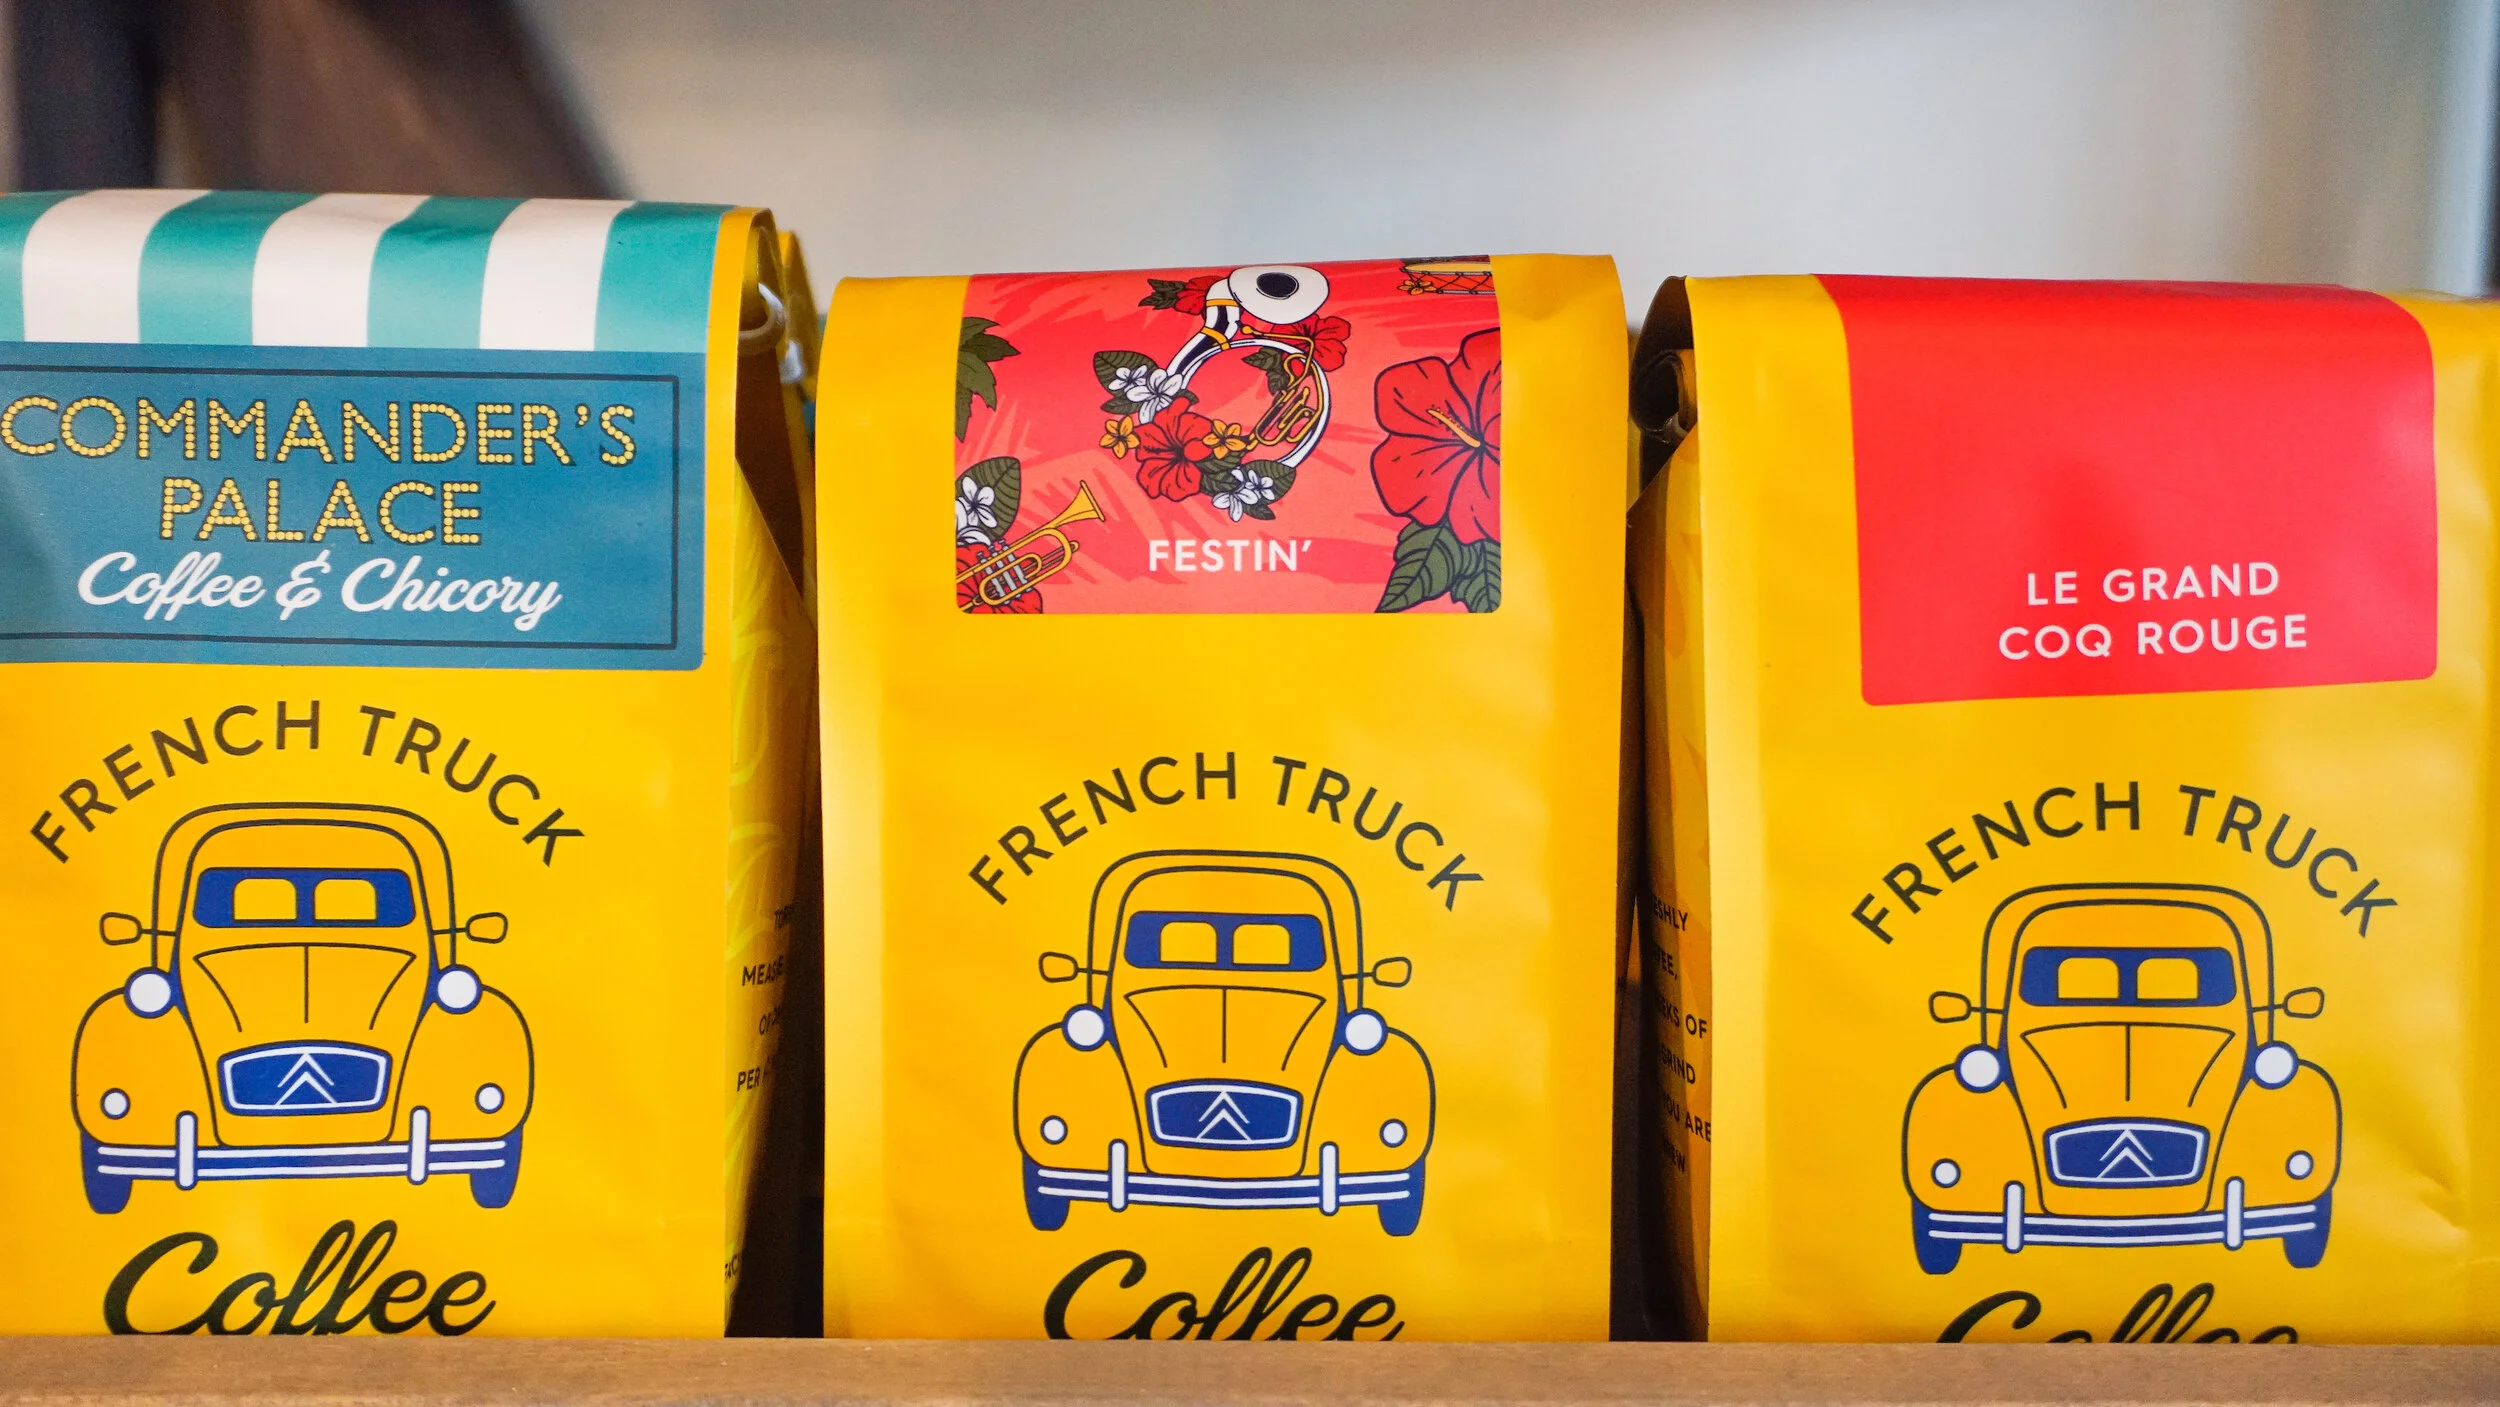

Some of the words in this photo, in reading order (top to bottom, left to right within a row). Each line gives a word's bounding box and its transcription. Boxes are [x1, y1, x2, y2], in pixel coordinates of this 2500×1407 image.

[0, 395, 636, 466] COMMANDER'S
[160, 476, 481, 545] PALACE
[77, 550, 267, 622] Coffee
[276, 549, 331, 621] &
[341, 555, 562, 632] Chicory
[1149, 538, 1313, 573] FESTIN'
[2027, 571, 2078, 606] LE
[2102, 562, 2280, 603] GRAND
[1999, 624, 2112, 659] COQ
[2137, 614, 2307, 655] ROUGE
[30, 700, 319, 864] FRENCH
[360, 705, 585, 867] TRUCK
[969, 751, 1236, 905] FRENCH
[1272, 755, 1484, 912] TRUCK
[1851, 781, 2140, 945] FRENCH
[2179, 784, 2398, 938] TRUCK
[1685, 1014, 1707, 1039] OF
[736, 1067, 761, 1092] PER
[1685, 1111, 1711, 1143] ARE
[103, 1219, 496, 1337] Coffee
[1043, 1246, 1406, 1342] Coffee
